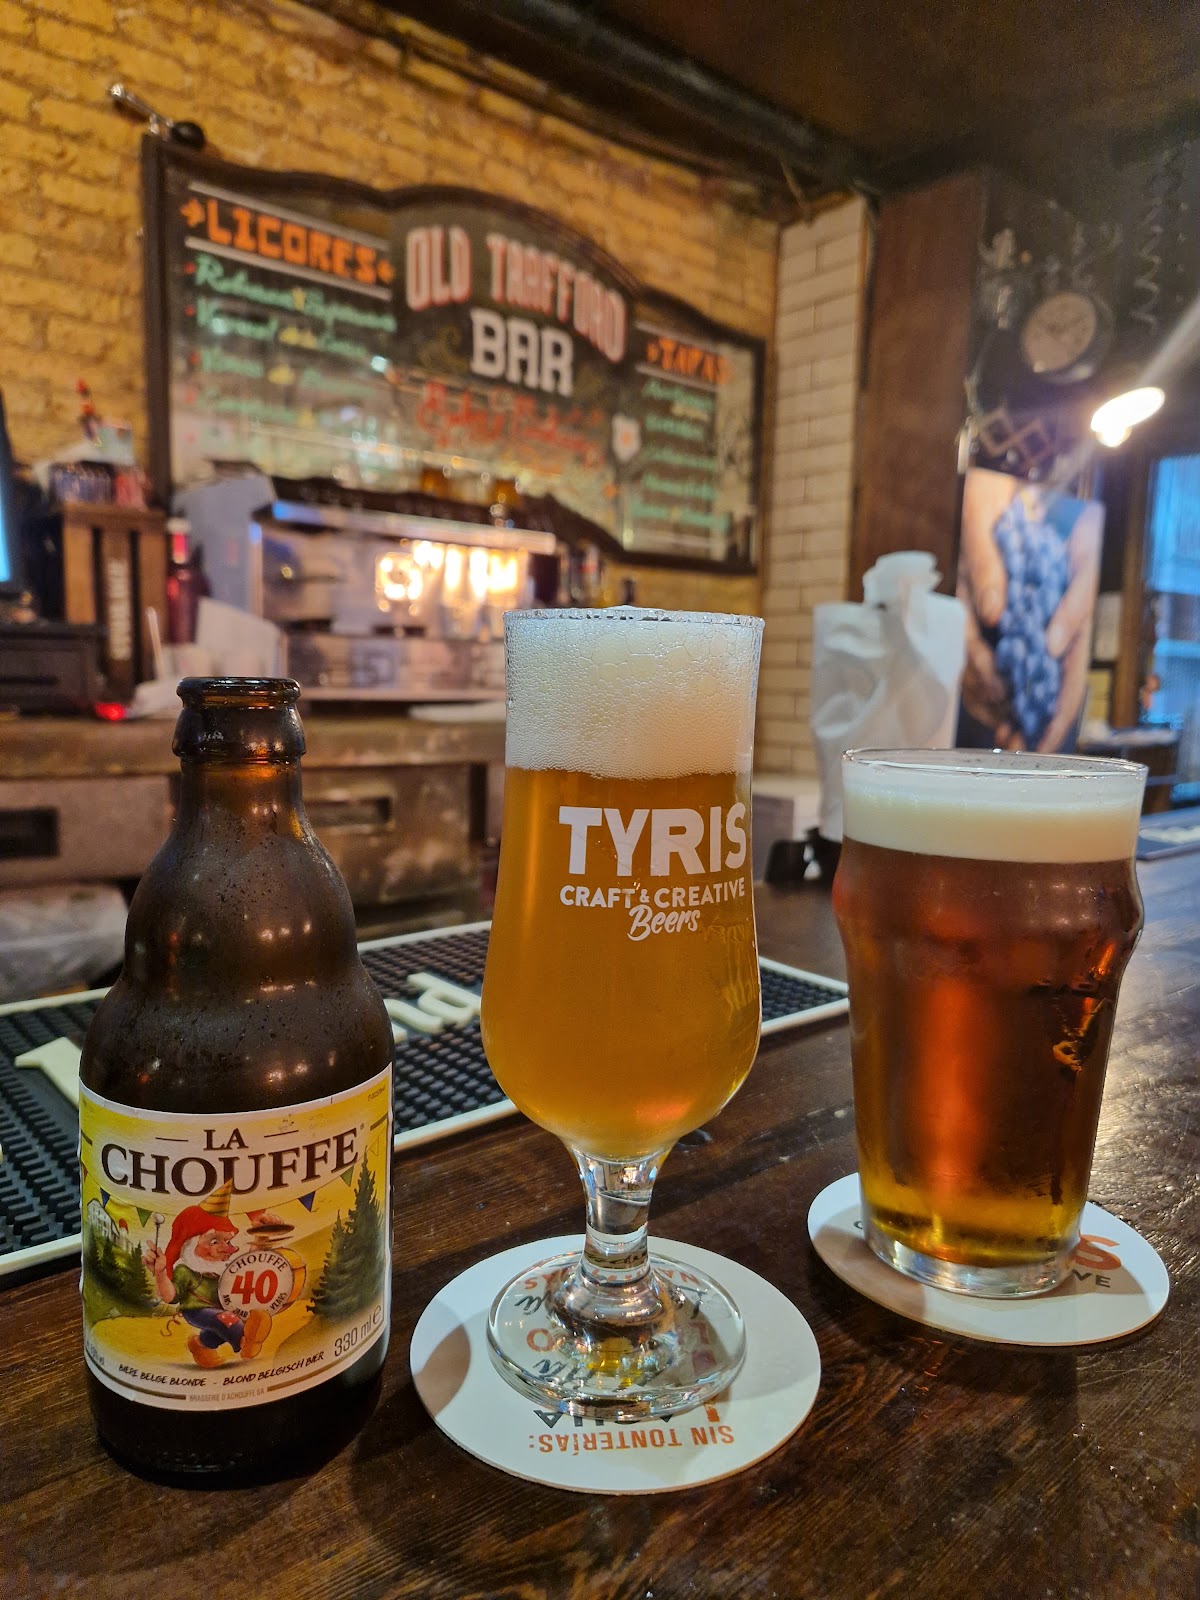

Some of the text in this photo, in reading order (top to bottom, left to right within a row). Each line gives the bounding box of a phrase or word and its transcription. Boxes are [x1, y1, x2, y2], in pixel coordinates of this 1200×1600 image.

[206, 199, 377, 284] LICORES
[405, 225, 473, 311] OLD
[487, 231, 627, 363] TRAFFORD
[469, 307, 574, 397] BAR
[558, 802, 747, 877] TYRIS
[559, 877, 745, 909] CRAFT & CREATIVE
[627, 904, 701, 942] Beers
[203, 1128, 249, 1151] LA
[101, 1128, 359, 1197] CHOUFFE
[228, 1253, 288, 1274] CHOUFFE
[230, 1269, 279, 1305] 40
[269, 1292, 287, 1310] YEARS
[334, 1327, 358, 1357] 330
[360, 1314, 372, 1340] ml
[140, 1371, 168, 1385] BELGE
[169, 1378, 207, 1387] BLONDE
[222, 1373, 257, 1386] BLOND
[257, 1358, 306, 1381] BELGISCH
[304, 1350, 325, 1367] BIER
[528, 1425, 735, 1456] SIN TONTERÍAS:
